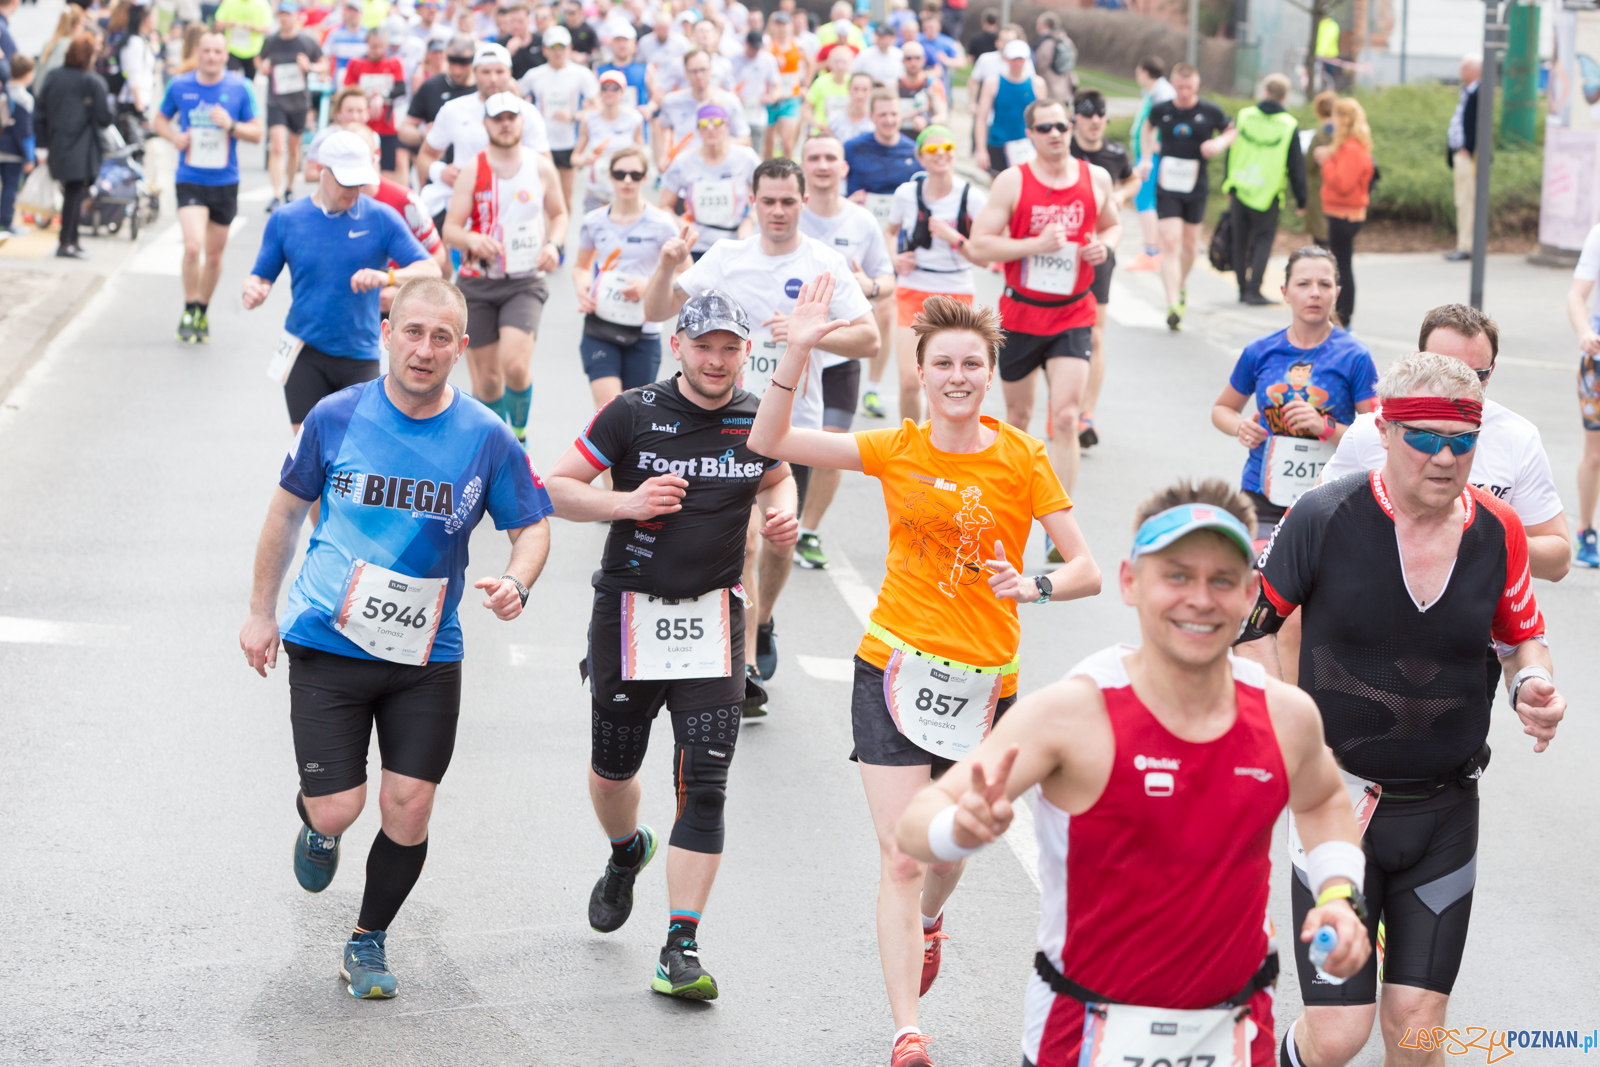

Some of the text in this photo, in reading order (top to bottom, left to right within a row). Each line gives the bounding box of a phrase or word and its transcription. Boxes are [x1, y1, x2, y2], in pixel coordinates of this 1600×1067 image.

[1033, 254, 1073, 272] 11990
[637, 449, 764, 478] Fogt Bikes
[934, 477, 957, 491] Man
[362, 473, 453, 516] BIEGA
[362, 596, 427, 629] 5946
[376, 627, 404, 638] Tomasz
[655, 617, 704, 640] 855
[667, 645, 693, 653] Łukasz
[915, 687, 969, 717] 857
[918, 716, 956, 730] Agnieszka
